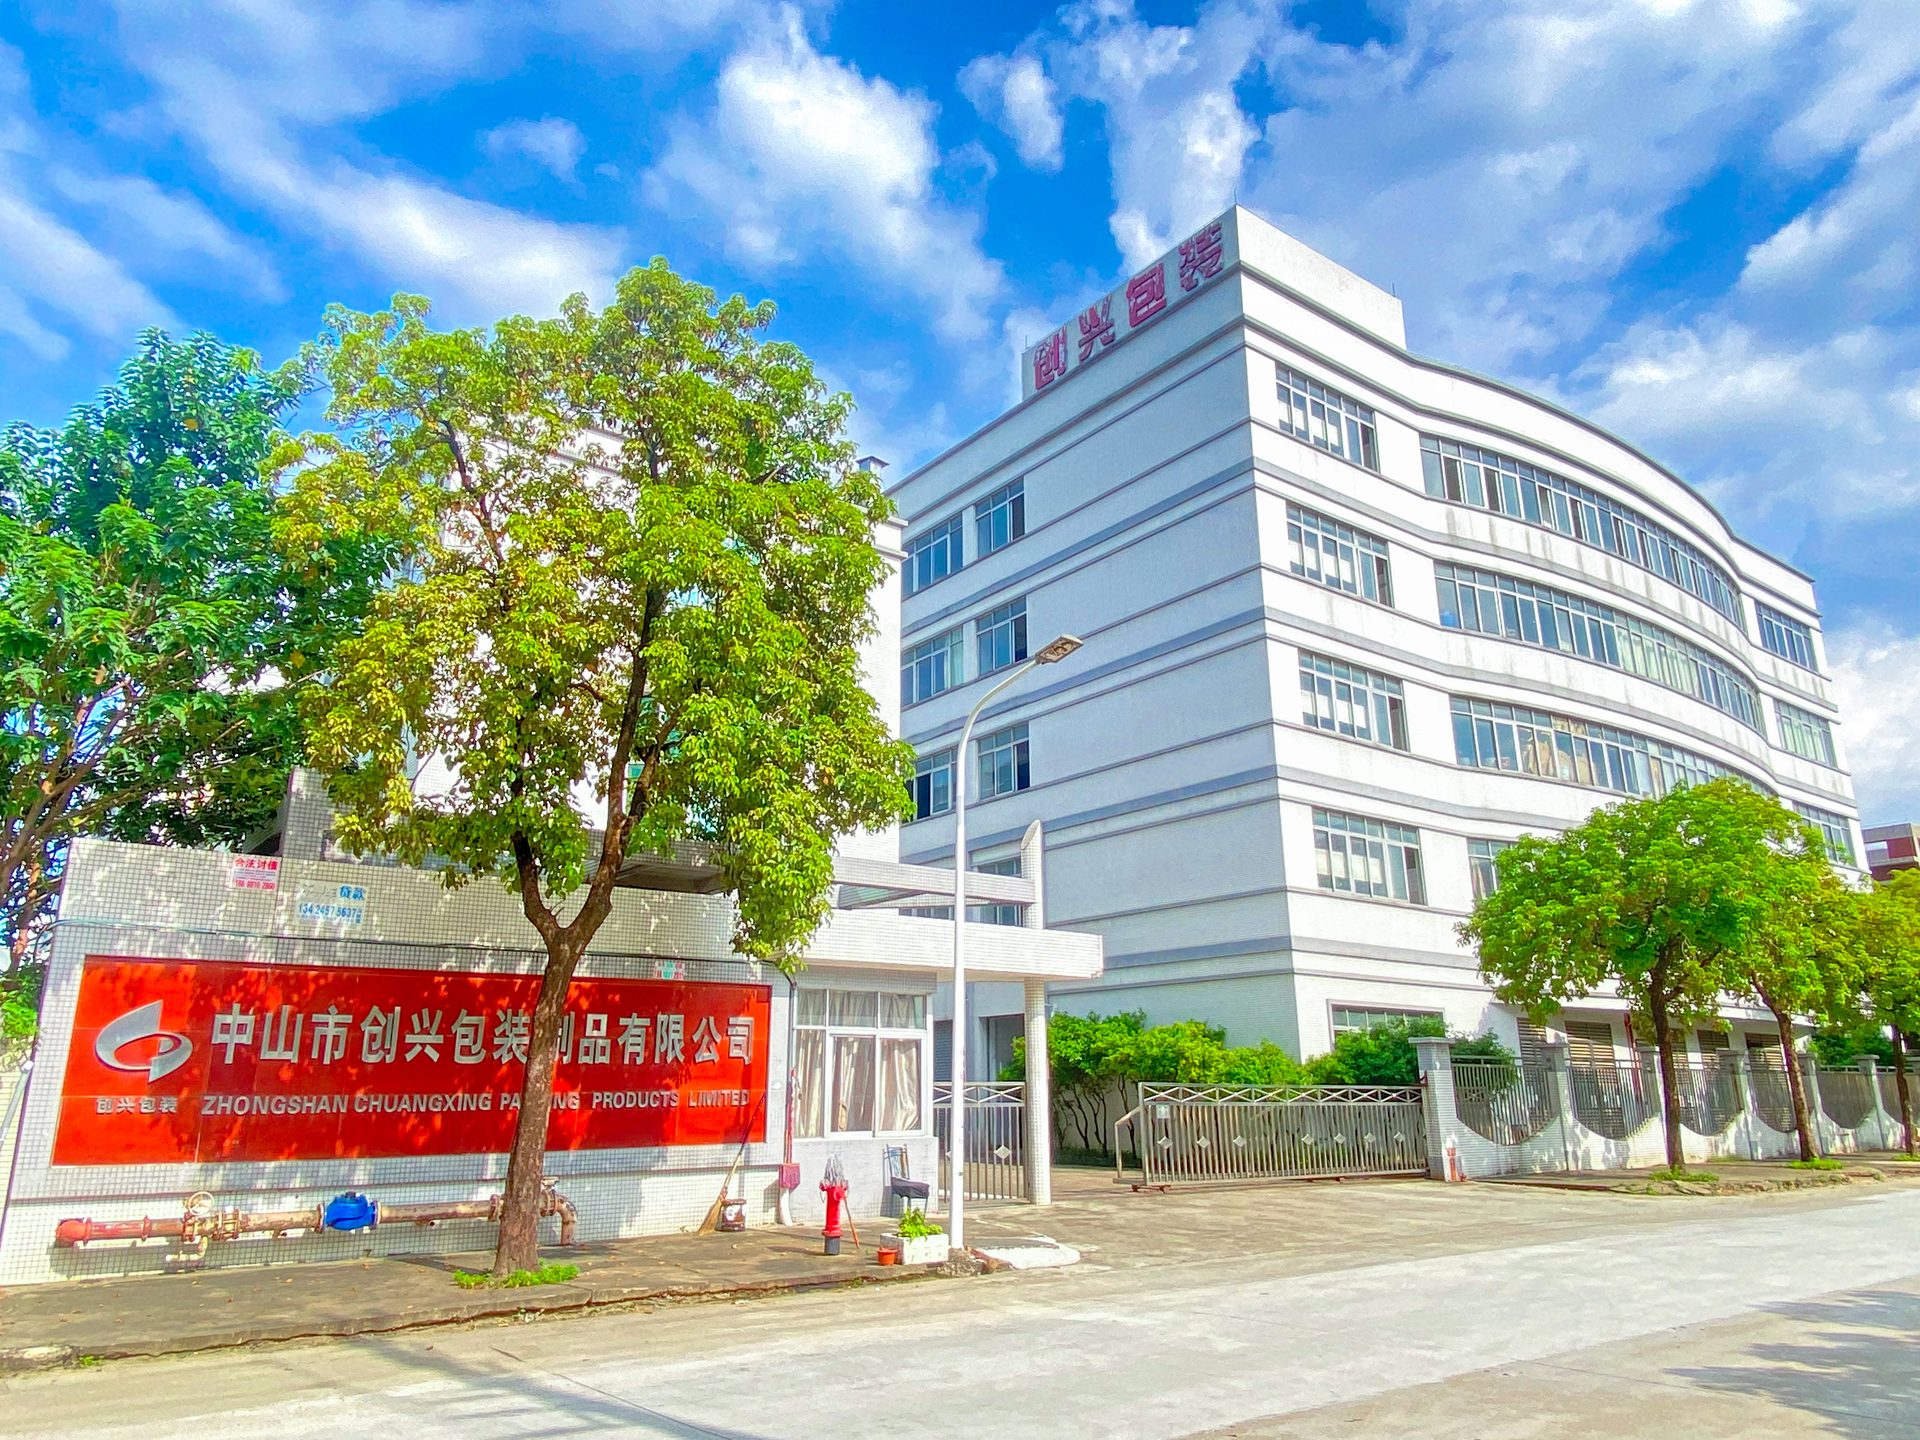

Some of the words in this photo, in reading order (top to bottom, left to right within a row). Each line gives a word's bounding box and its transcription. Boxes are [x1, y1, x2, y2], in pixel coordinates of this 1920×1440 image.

[1033, 221, 1224, 391] 创兴包装
[234, 857, 278, 870] 合法讨债
[201, 1094, 349, 1116] ZHONGSHAN
[353, 1092, 491, 1113] CHUANGXING
[499, 1091, 580, 1111] PAING
[591, 1089, 679, 1109] PRODUCTS
[688, 1088, 750, 1108] LIMITED
